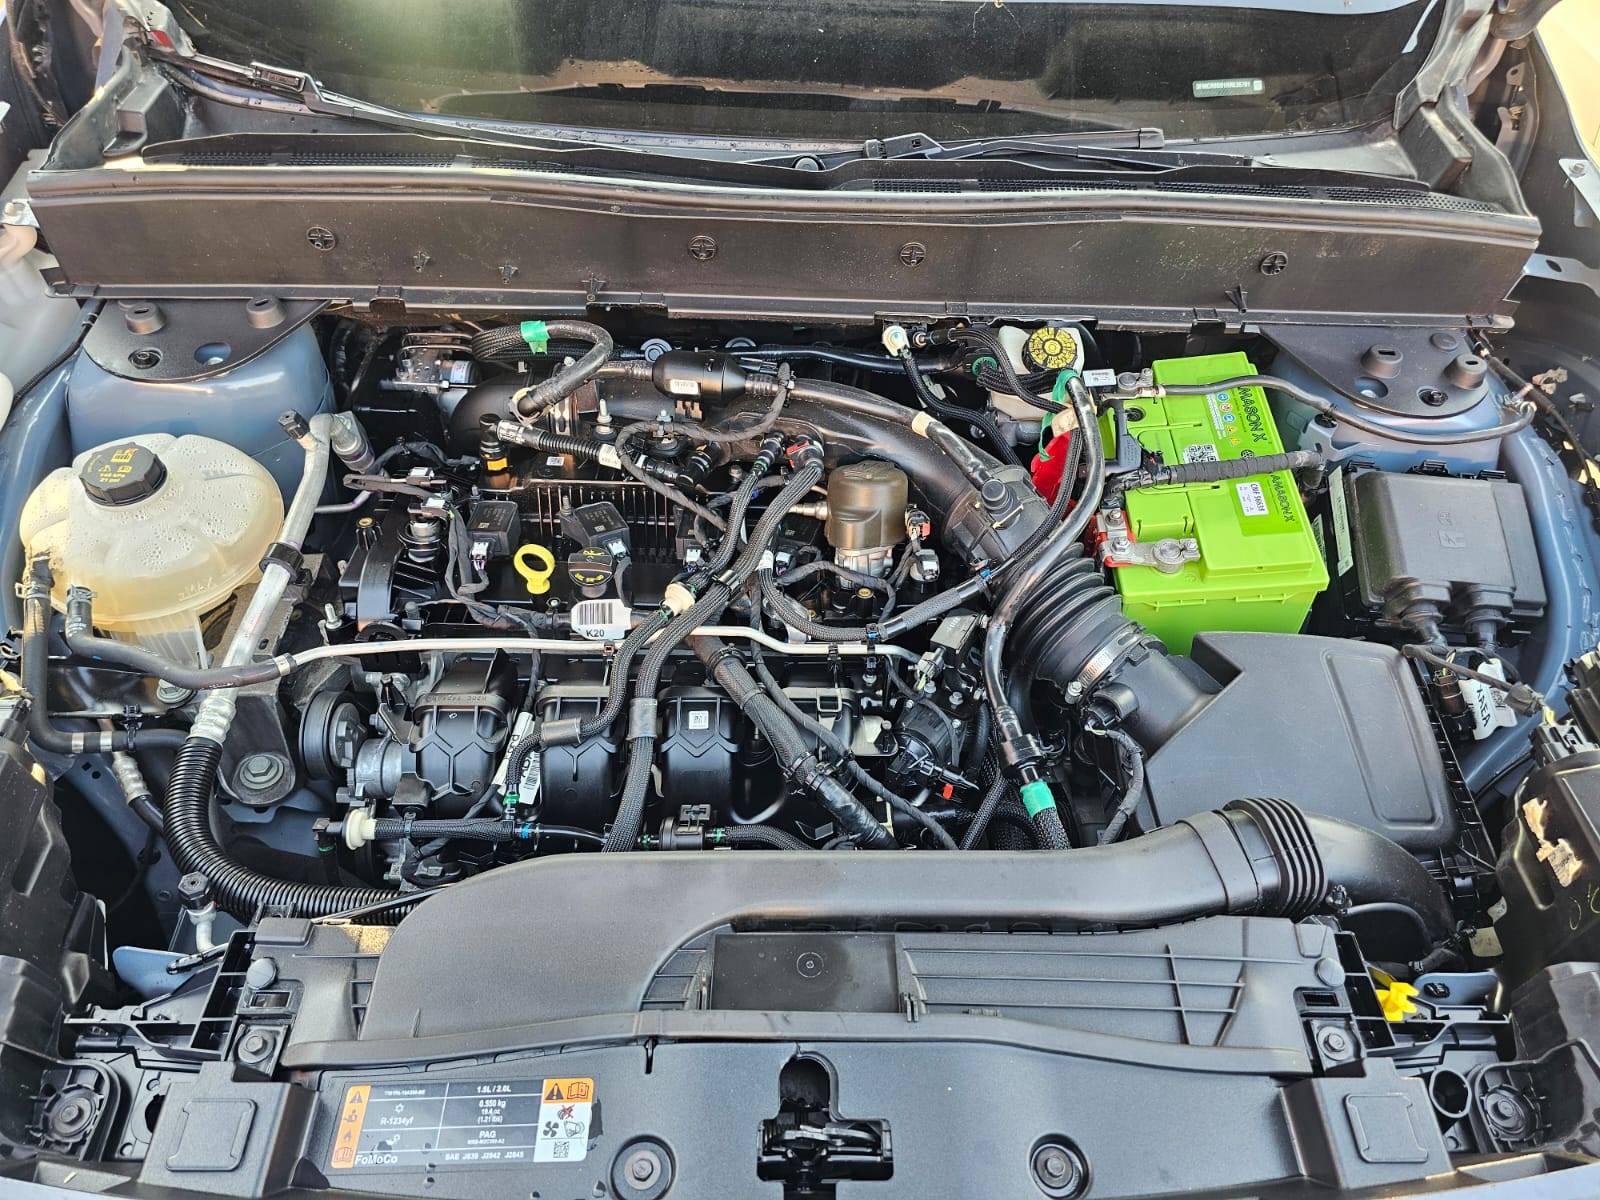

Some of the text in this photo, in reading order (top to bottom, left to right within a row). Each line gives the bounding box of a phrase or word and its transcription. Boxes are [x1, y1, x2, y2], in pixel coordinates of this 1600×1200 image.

[1237, 386, 1263, 432] MASON
[585, 628, 605, 638] K20
[380, 1115, 414, 1126] R-1234yf
[478, 1130, 497, 1139] PAG
[354, 1154, 399, 1165] FoMoCo
[445, 1152, 460, 1161] SAE
